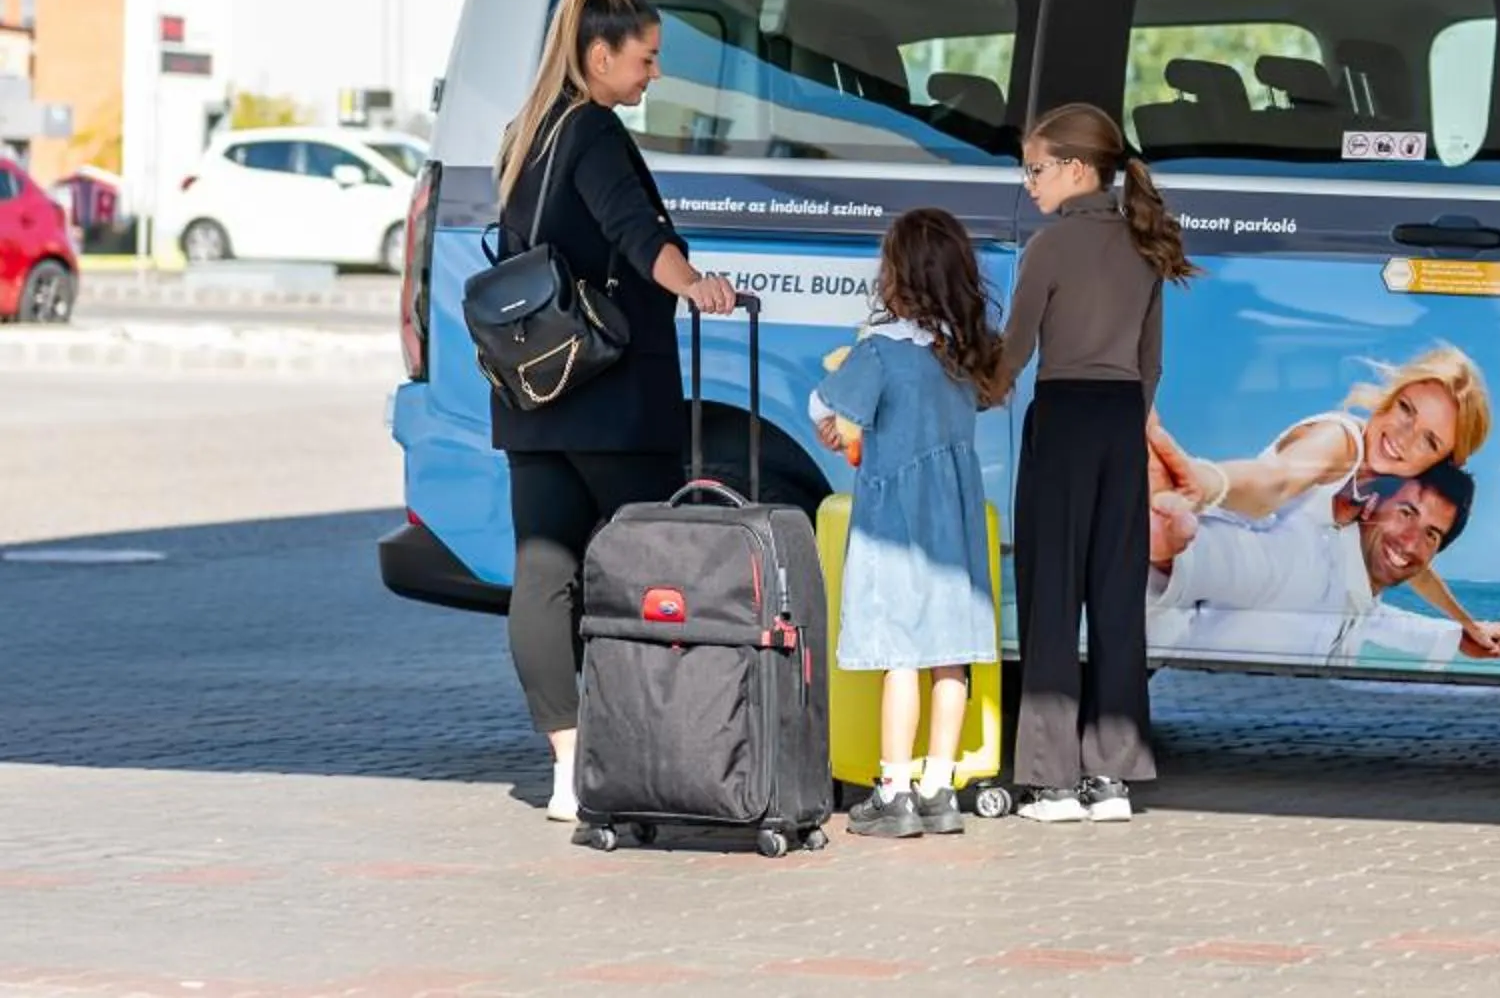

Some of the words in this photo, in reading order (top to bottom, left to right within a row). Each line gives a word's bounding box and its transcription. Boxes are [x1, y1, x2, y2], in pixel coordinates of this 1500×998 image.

[748, 201, 767, 213] az
[1173, 213, 1230, 231] ltozott
[1233, 217, 1297, 234] parkoló
[735, 272, 804, 294] HOTEL
